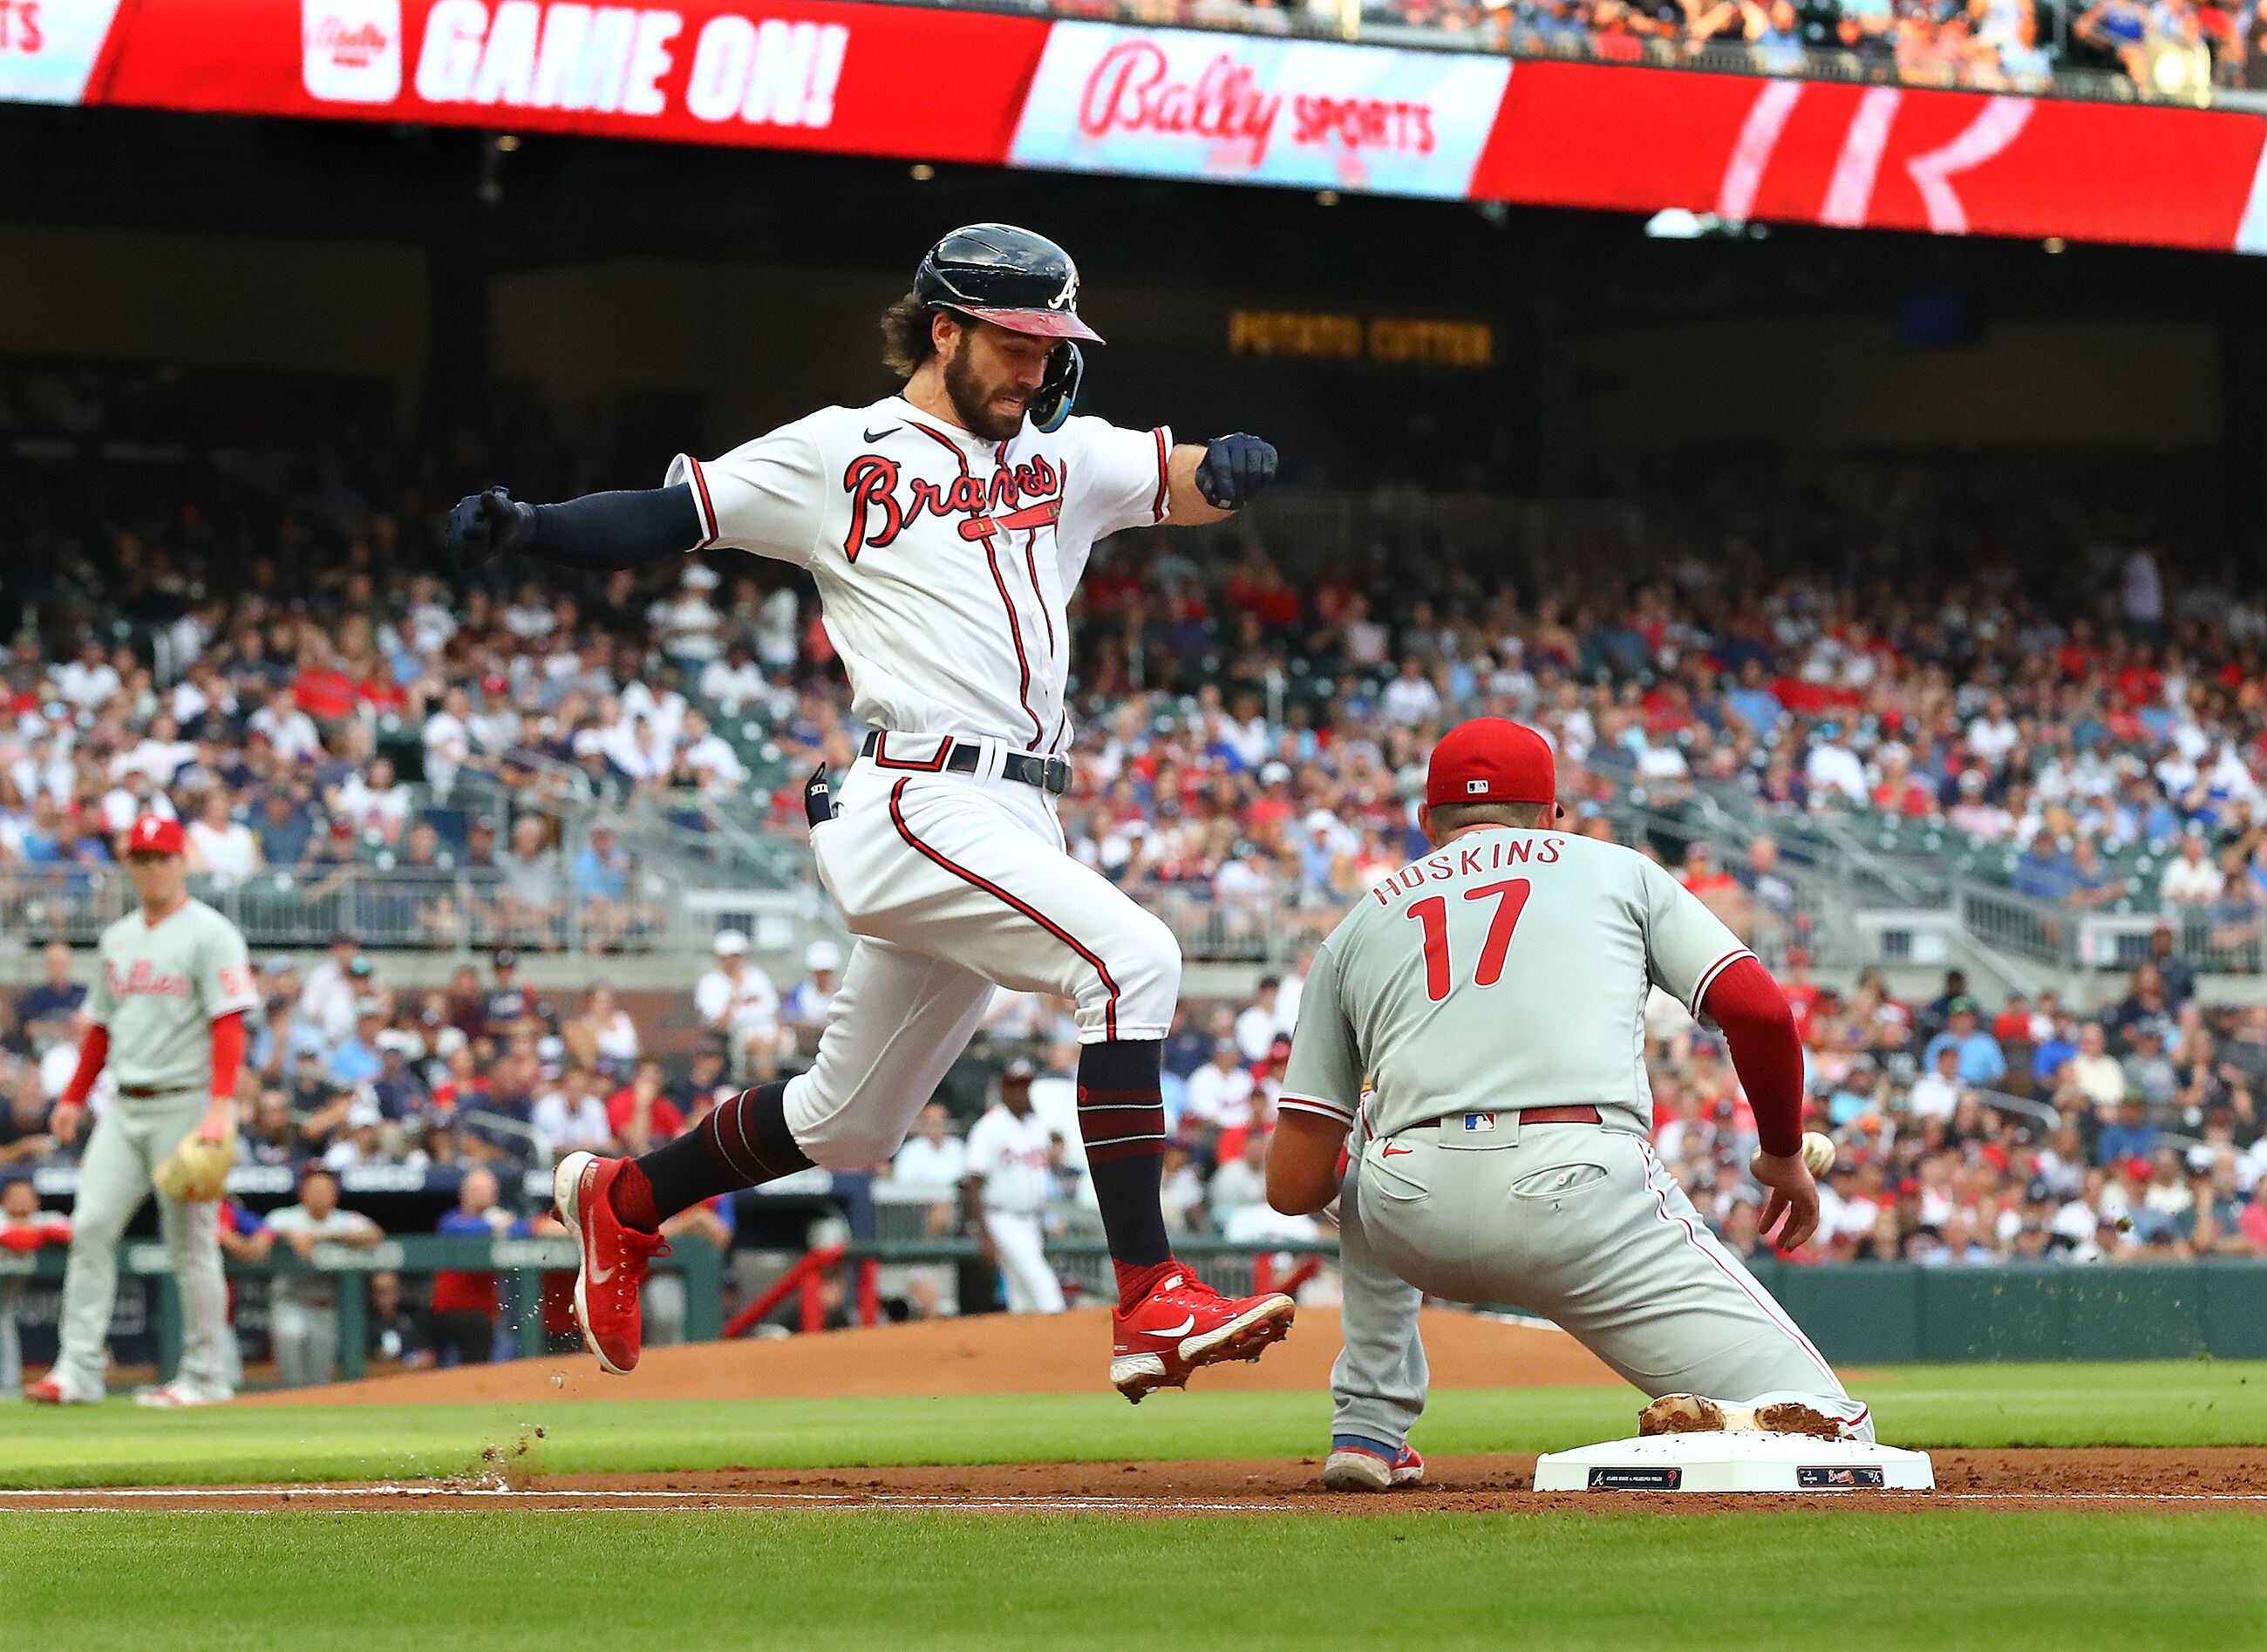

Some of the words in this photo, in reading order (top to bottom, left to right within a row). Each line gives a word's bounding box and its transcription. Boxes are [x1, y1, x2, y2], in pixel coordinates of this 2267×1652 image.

[415, 0, 683, 117] GAME
[685, 15, 851, 129] ON!
[1078, 39, 1283, 169] Bally
[1292, 93, 1437, 155] SPORTS
[843, 453, 1058, 564] Braves
[1371, 837, 1566, 908] HOSKINS
[1406, 877, 1535, 1004] 17
